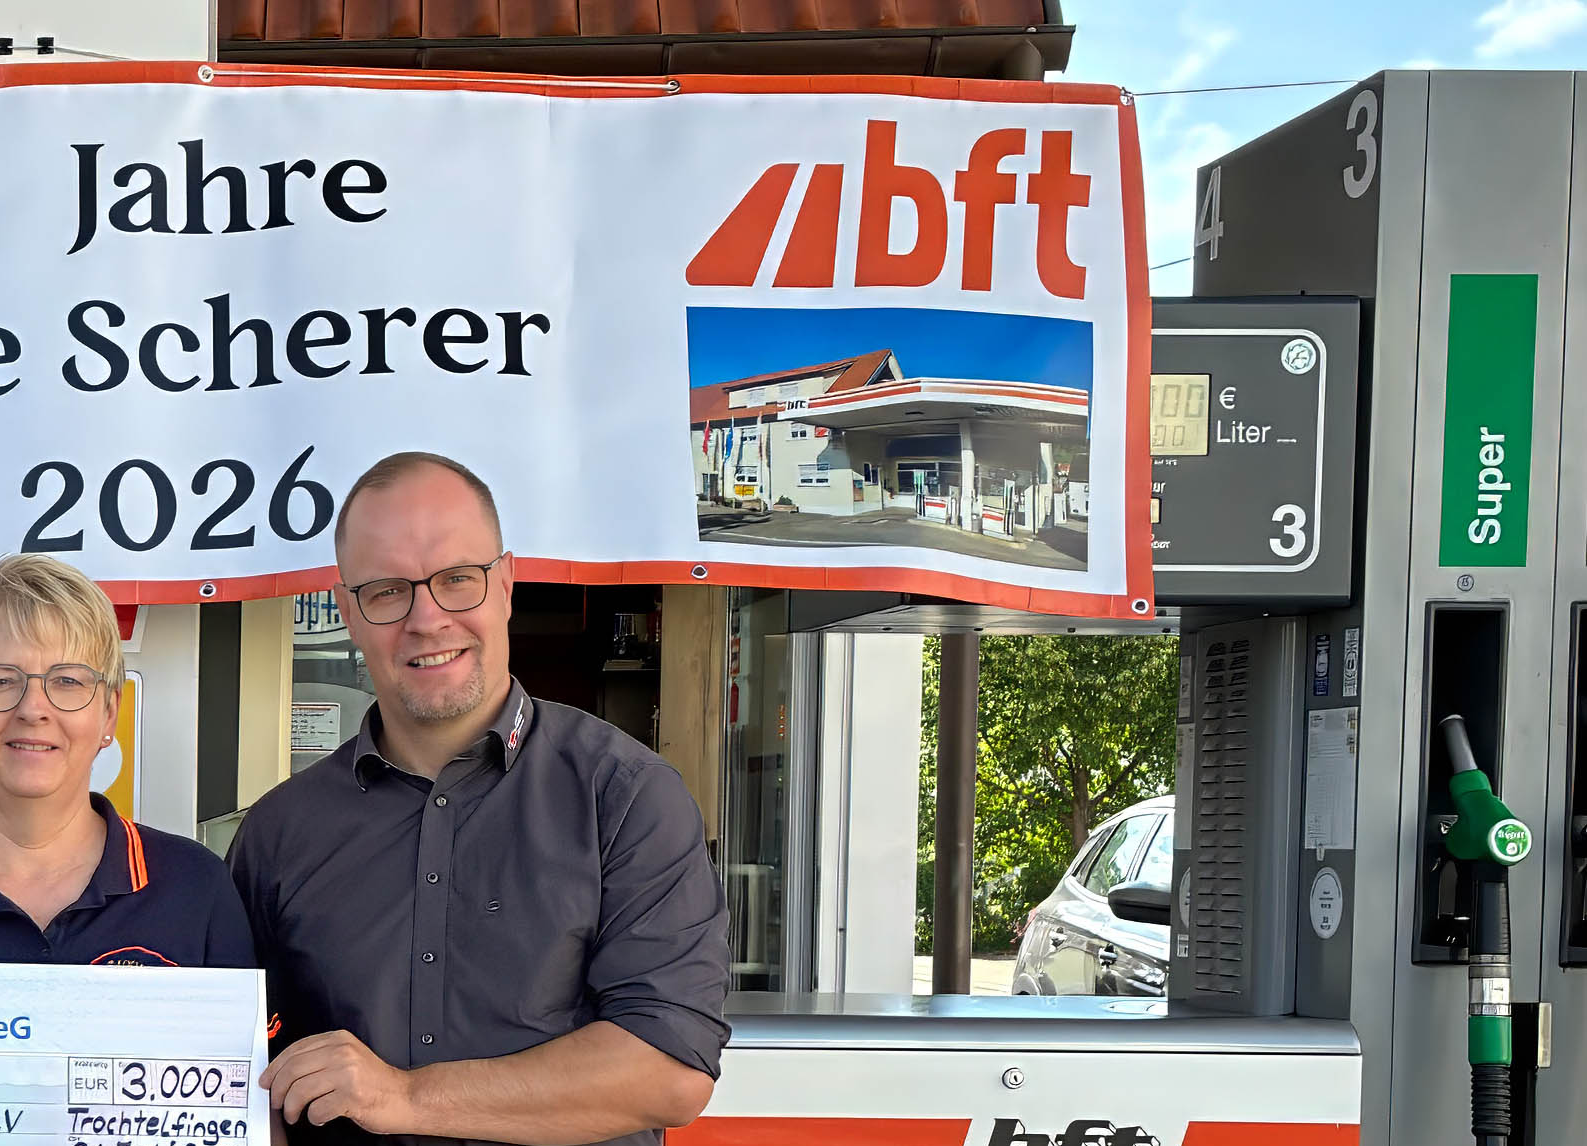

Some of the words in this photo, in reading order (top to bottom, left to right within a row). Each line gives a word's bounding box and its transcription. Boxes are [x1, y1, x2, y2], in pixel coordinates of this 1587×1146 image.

[1343, 88, 1379, 199] 3
[66, 138, 388, 255] Jahre
[855, 119, 1092, 300] bft
[1194, 165, 1224, 261] 4
[62, 291, 551, 394] Scherer
[1216, 420, 1271, 443] Liter
[1219, 386, 1237, 410] €
[20, 445, 335, 555] 2026
[1269, 504, 1307, 558] 3
[1469, 426, 1506, 546] Super
[67, 1107, 248, 1146] Trochtelfingen
[74, 1077, 108, 1091] EUR
